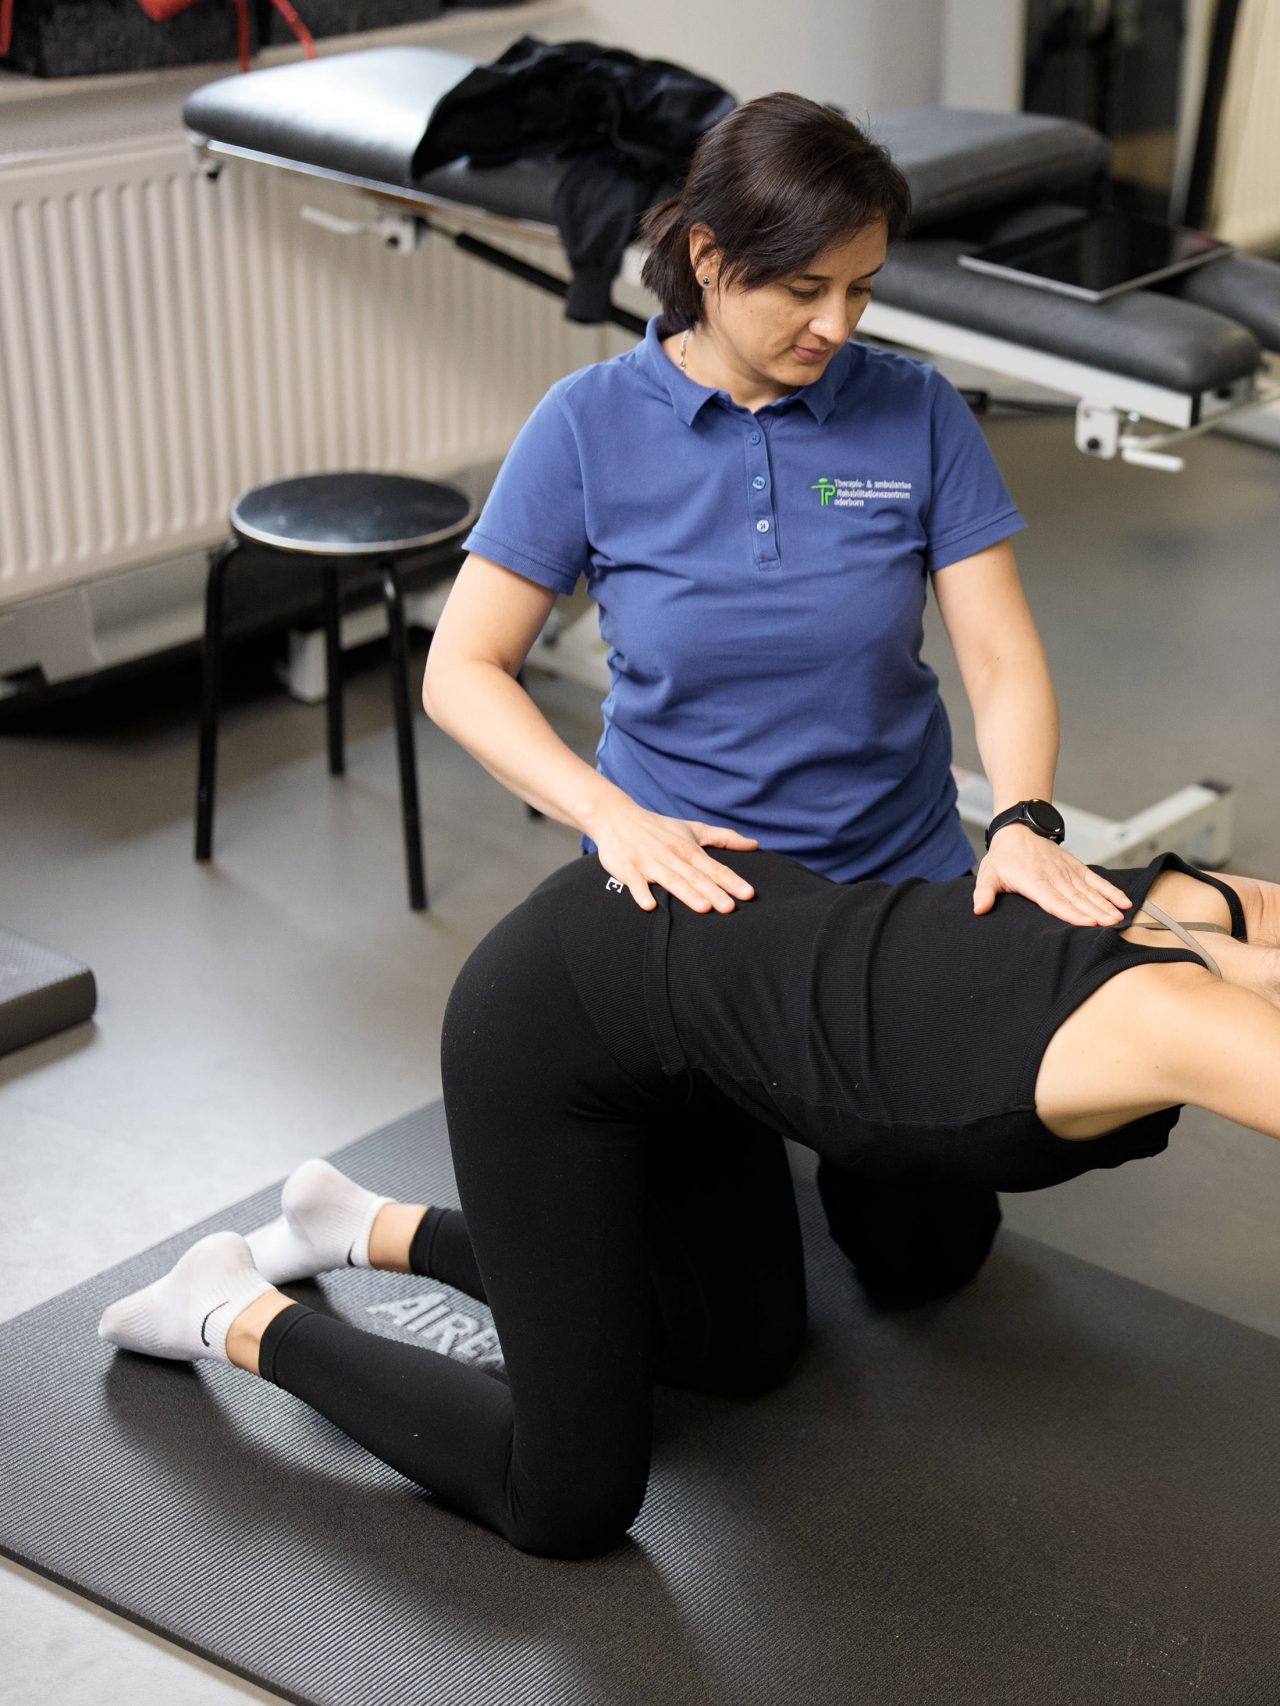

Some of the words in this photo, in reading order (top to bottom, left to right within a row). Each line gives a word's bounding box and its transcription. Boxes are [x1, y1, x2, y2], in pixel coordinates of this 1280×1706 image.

[834, 479, 865, 489] Therapie-
[866, 479, 873, 489] &
[837, 489, 911, 499] Rehabilitationszentrum
